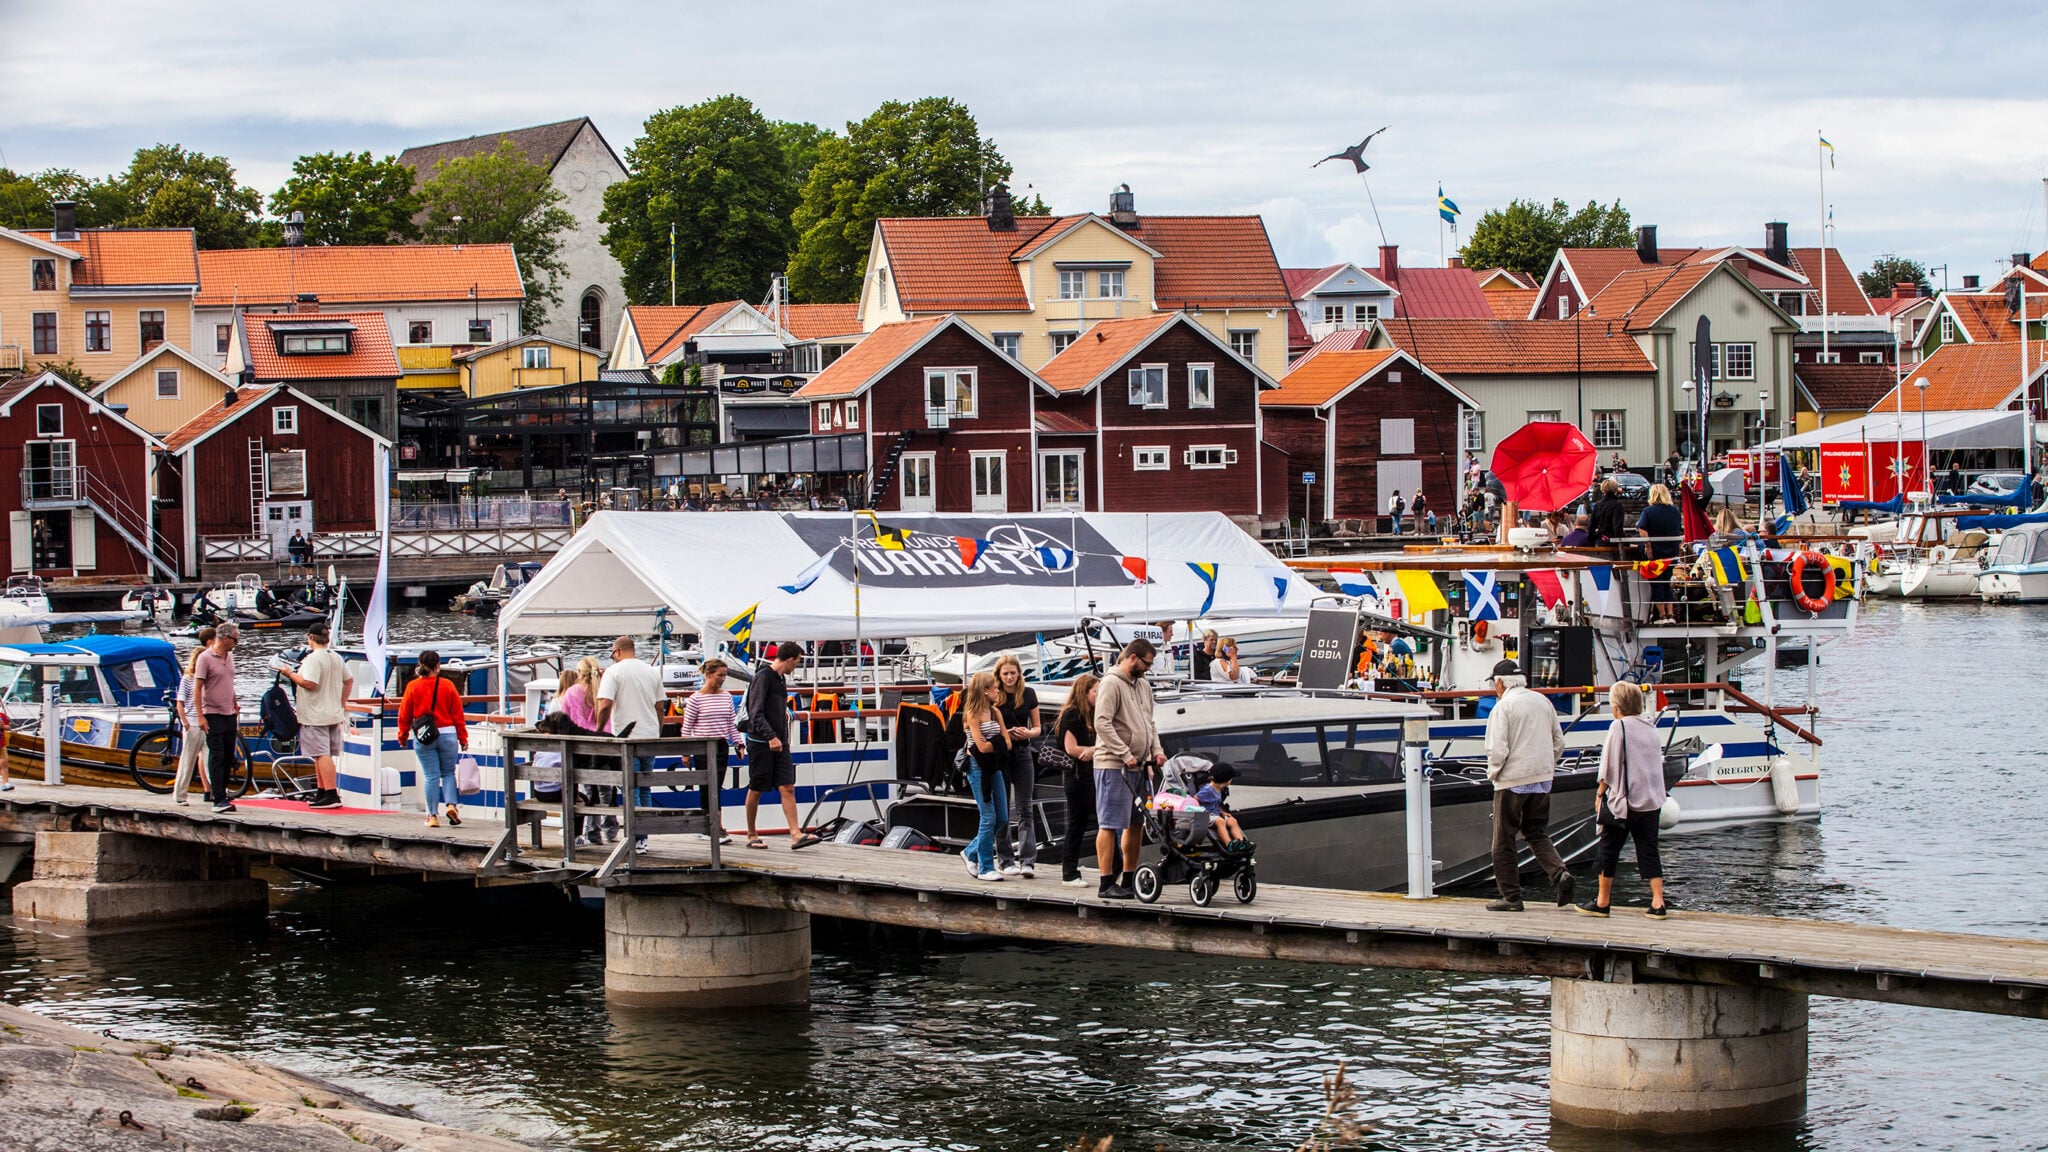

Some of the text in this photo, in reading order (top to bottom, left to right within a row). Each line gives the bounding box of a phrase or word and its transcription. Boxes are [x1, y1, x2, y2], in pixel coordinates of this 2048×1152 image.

[839, 535, 962, 549] ÖREUNDS
[1309, 649, 1342, 660] VIGGO
[1717, 765, 1771, 775] ÖREGRUND
